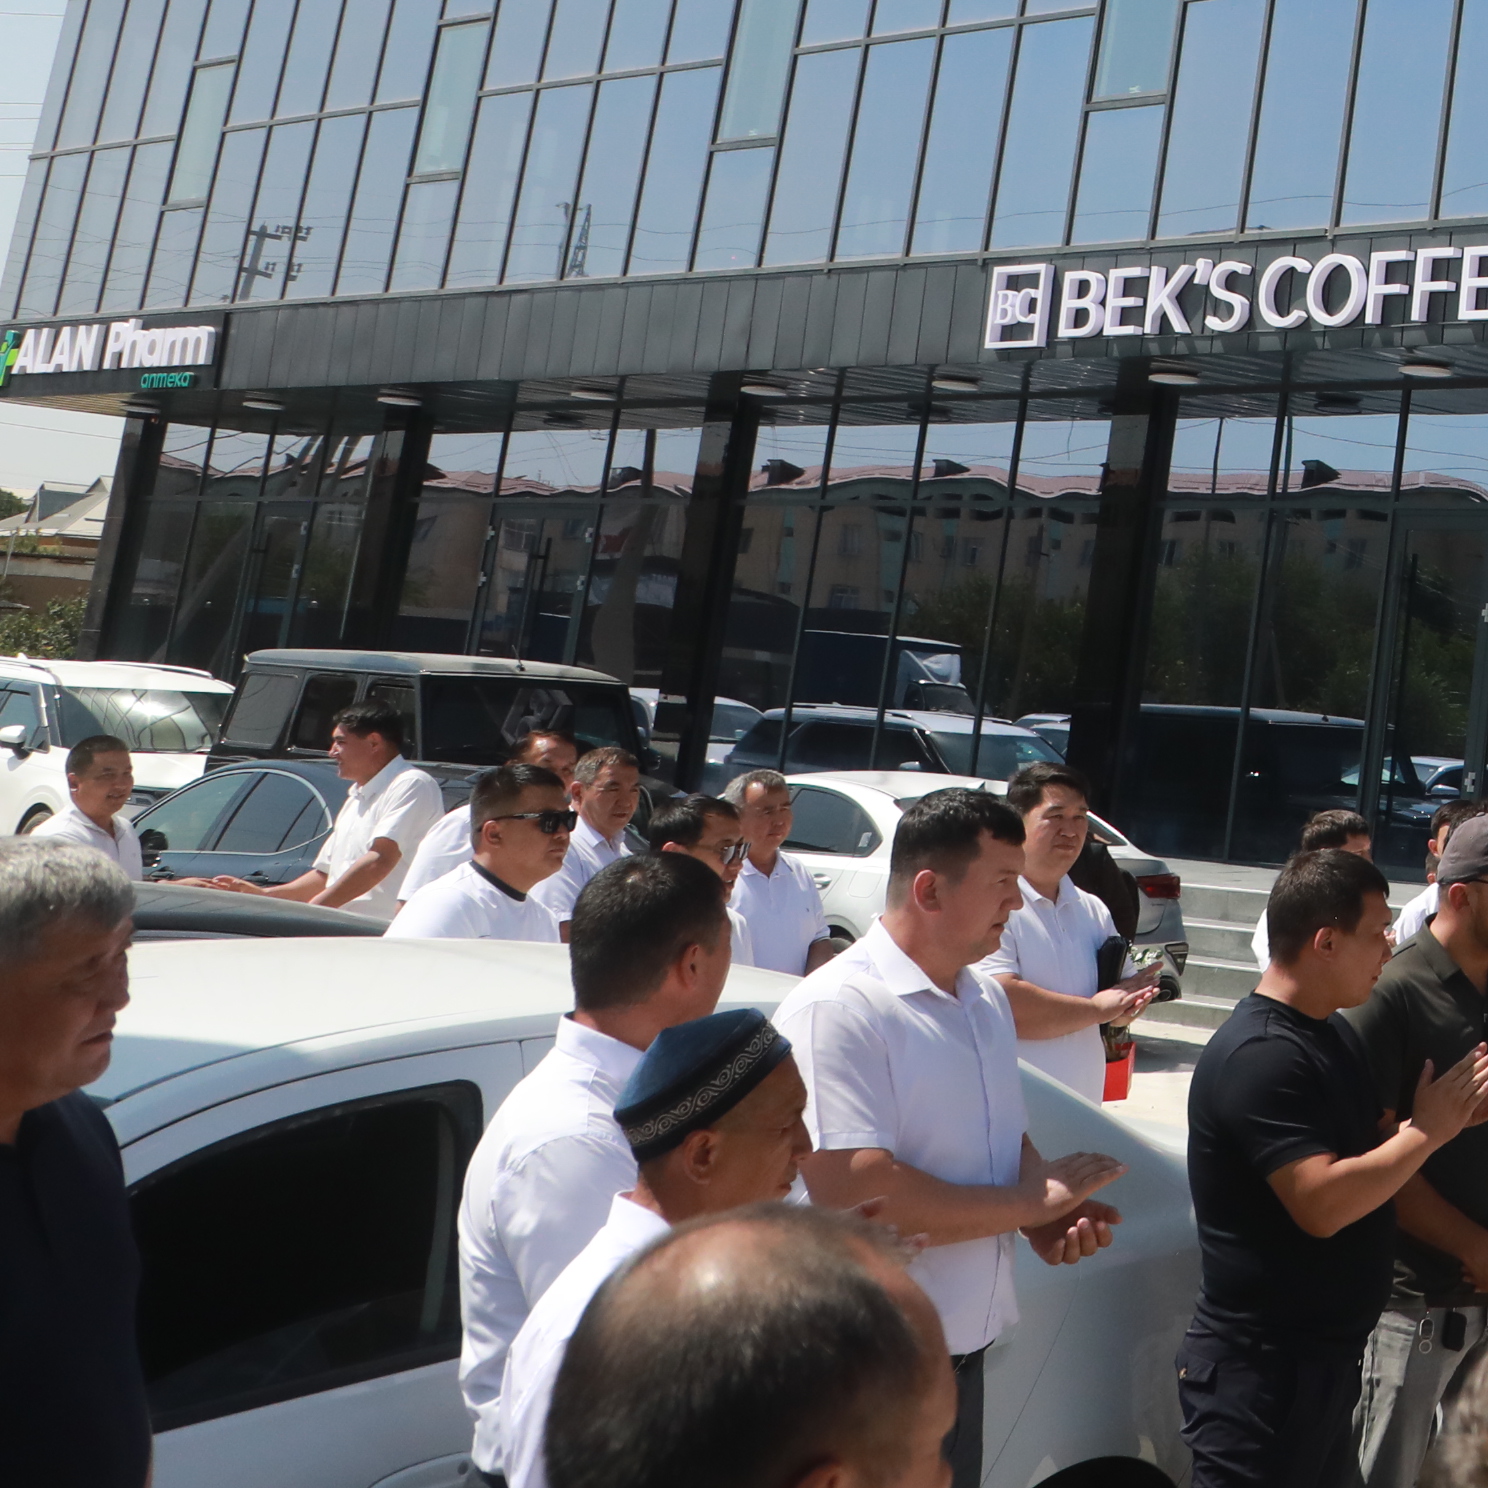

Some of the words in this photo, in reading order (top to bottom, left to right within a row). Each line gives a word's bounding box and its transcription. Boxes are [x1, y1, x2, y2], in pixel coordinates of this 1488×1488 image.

[1057, 258, 1252, 338] BEK'S
[11, 324, 107, 374] ALAN
[103, 318, 216, 370] Pharm
